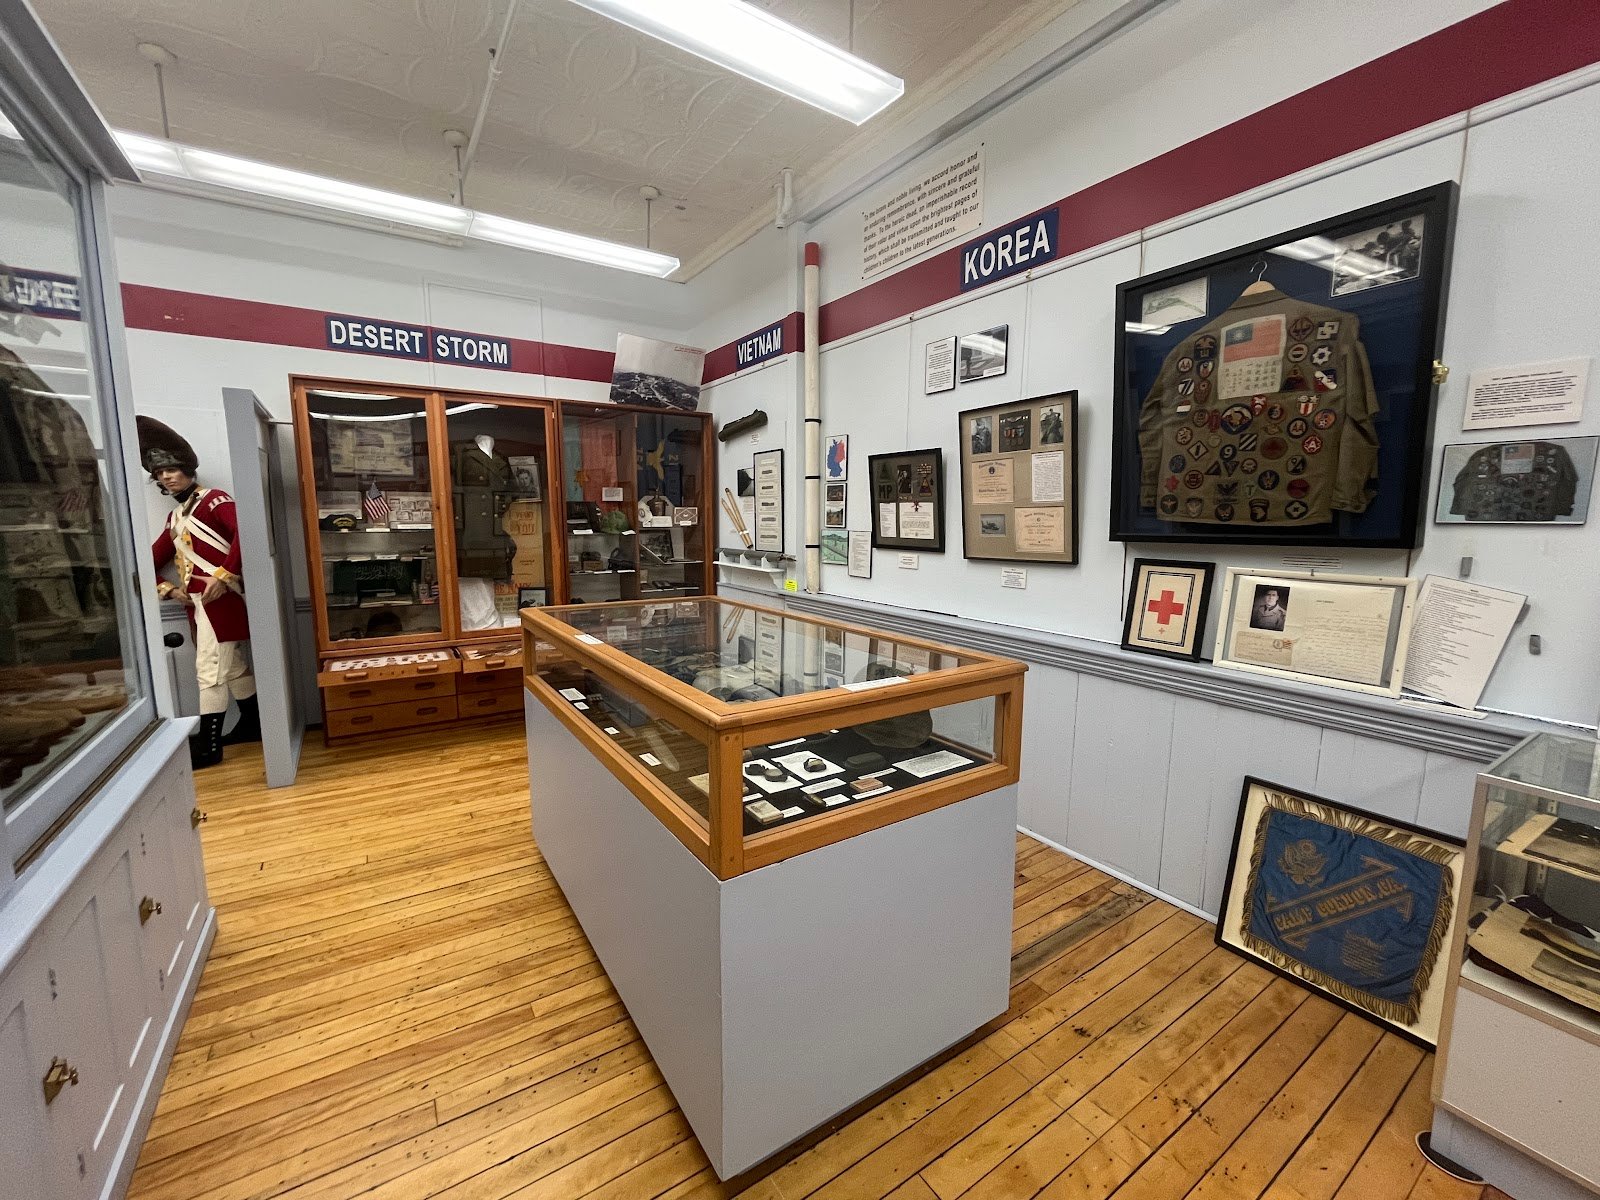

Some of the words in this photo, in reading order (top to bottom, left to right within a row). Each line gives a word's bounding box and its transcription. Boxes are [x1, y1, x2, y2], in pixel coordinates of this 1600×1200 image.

[918, 192, 926, 202] with
[928, 182, 946, 196] sincere
[948, 174, 958, 186] and
[958, 162, 980, 182] grateful
[932, 166, 948, 182] accord
[950, 160, 966, 172] honor
[966, 151, 978, 164] and
[910, 218, 920, 228] upon
[930, 202, 953, 218] brightest
[954, 194, 970, 208] pages
[972, 188, 978, 198] of
[926, 188, 958, 208] imperishable
[960, 176, 978, 192] record
[908, 223, 934, 241] transmitted
[934, 218, 944, 228] and
[944, 210, 962, 224] taught
[962, 208, 968, 216] to
[970, 202, 980, 212] our
[912, 238, 926, 250] latest
[964, 220, 1050, 284] KOREA
[330, 320, 424, 354] DESERT
[436, 334, 508, 364] STORM
[738, 328, 781, 364] VIETNAM
[1224, 446, 1233, 458] 9
